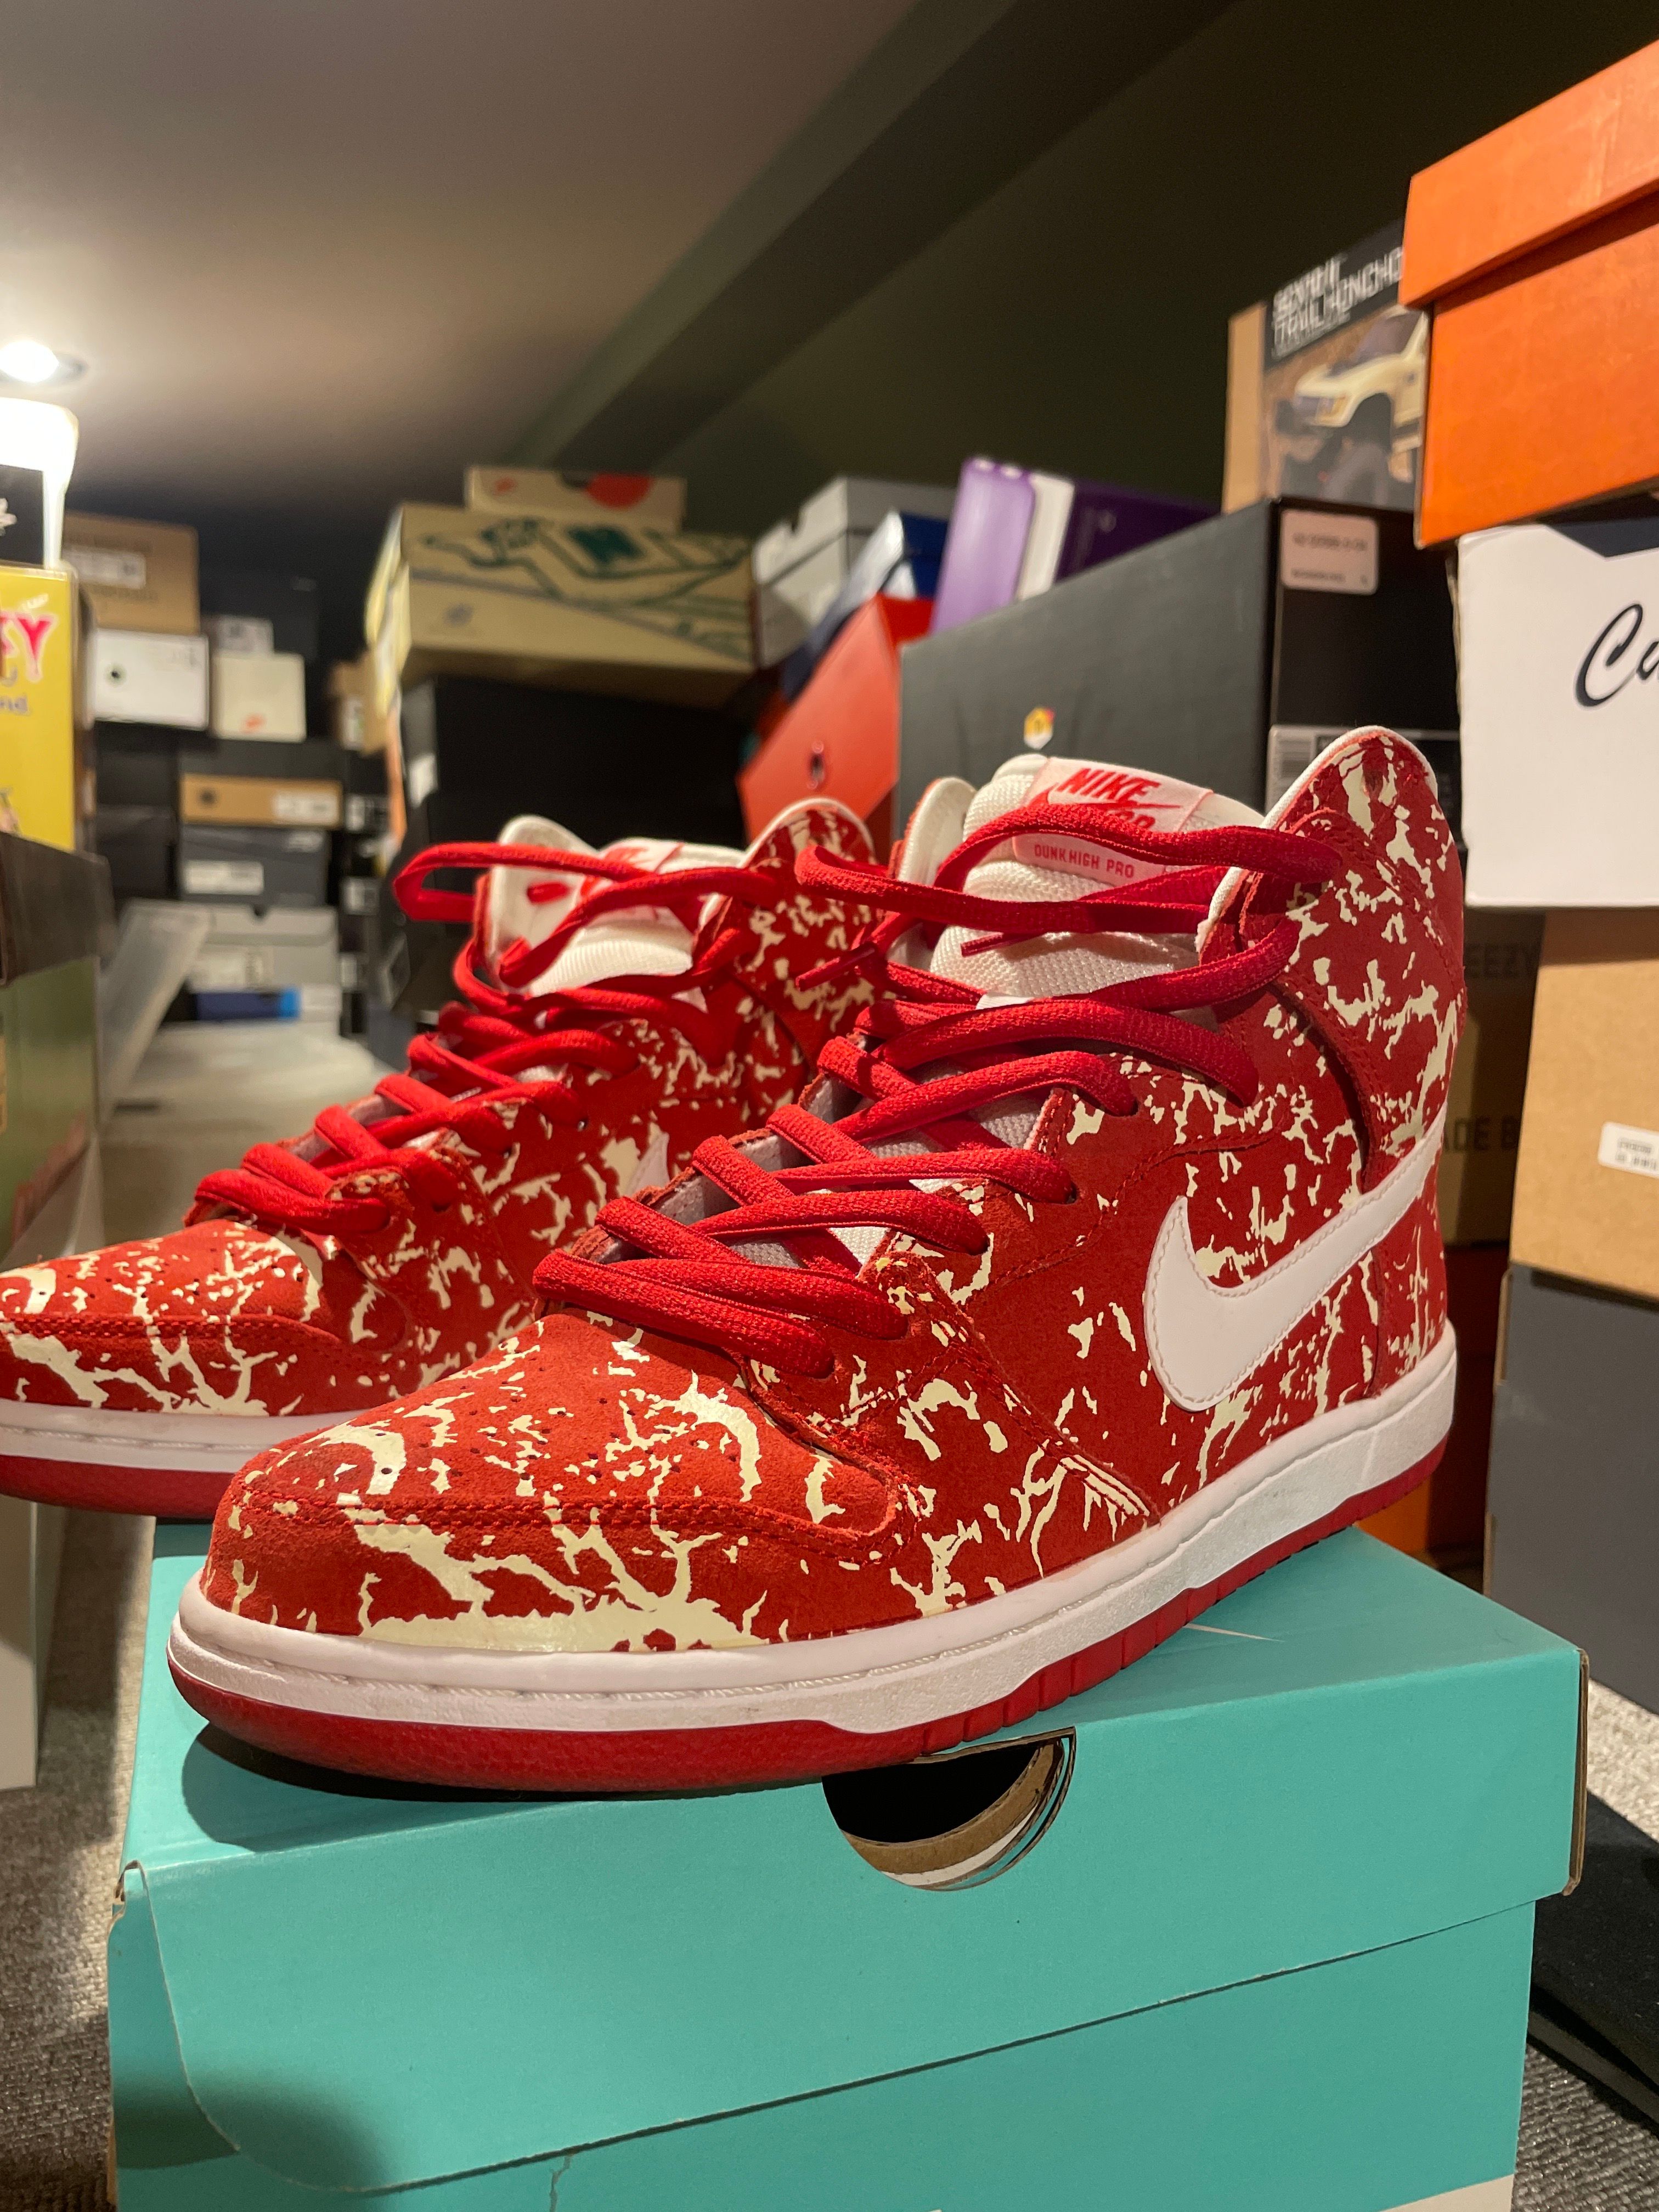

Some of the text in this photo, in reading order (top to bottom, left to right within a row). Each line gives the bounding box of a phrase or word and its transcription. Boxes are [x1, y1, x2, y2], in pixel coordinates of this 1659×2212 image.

[1274, 298, 1324, 345] TRAIL
[1057, 768, 1161, 804] NIKE
[1034, 844, 1135, 878] DUNK HIGH PRO
